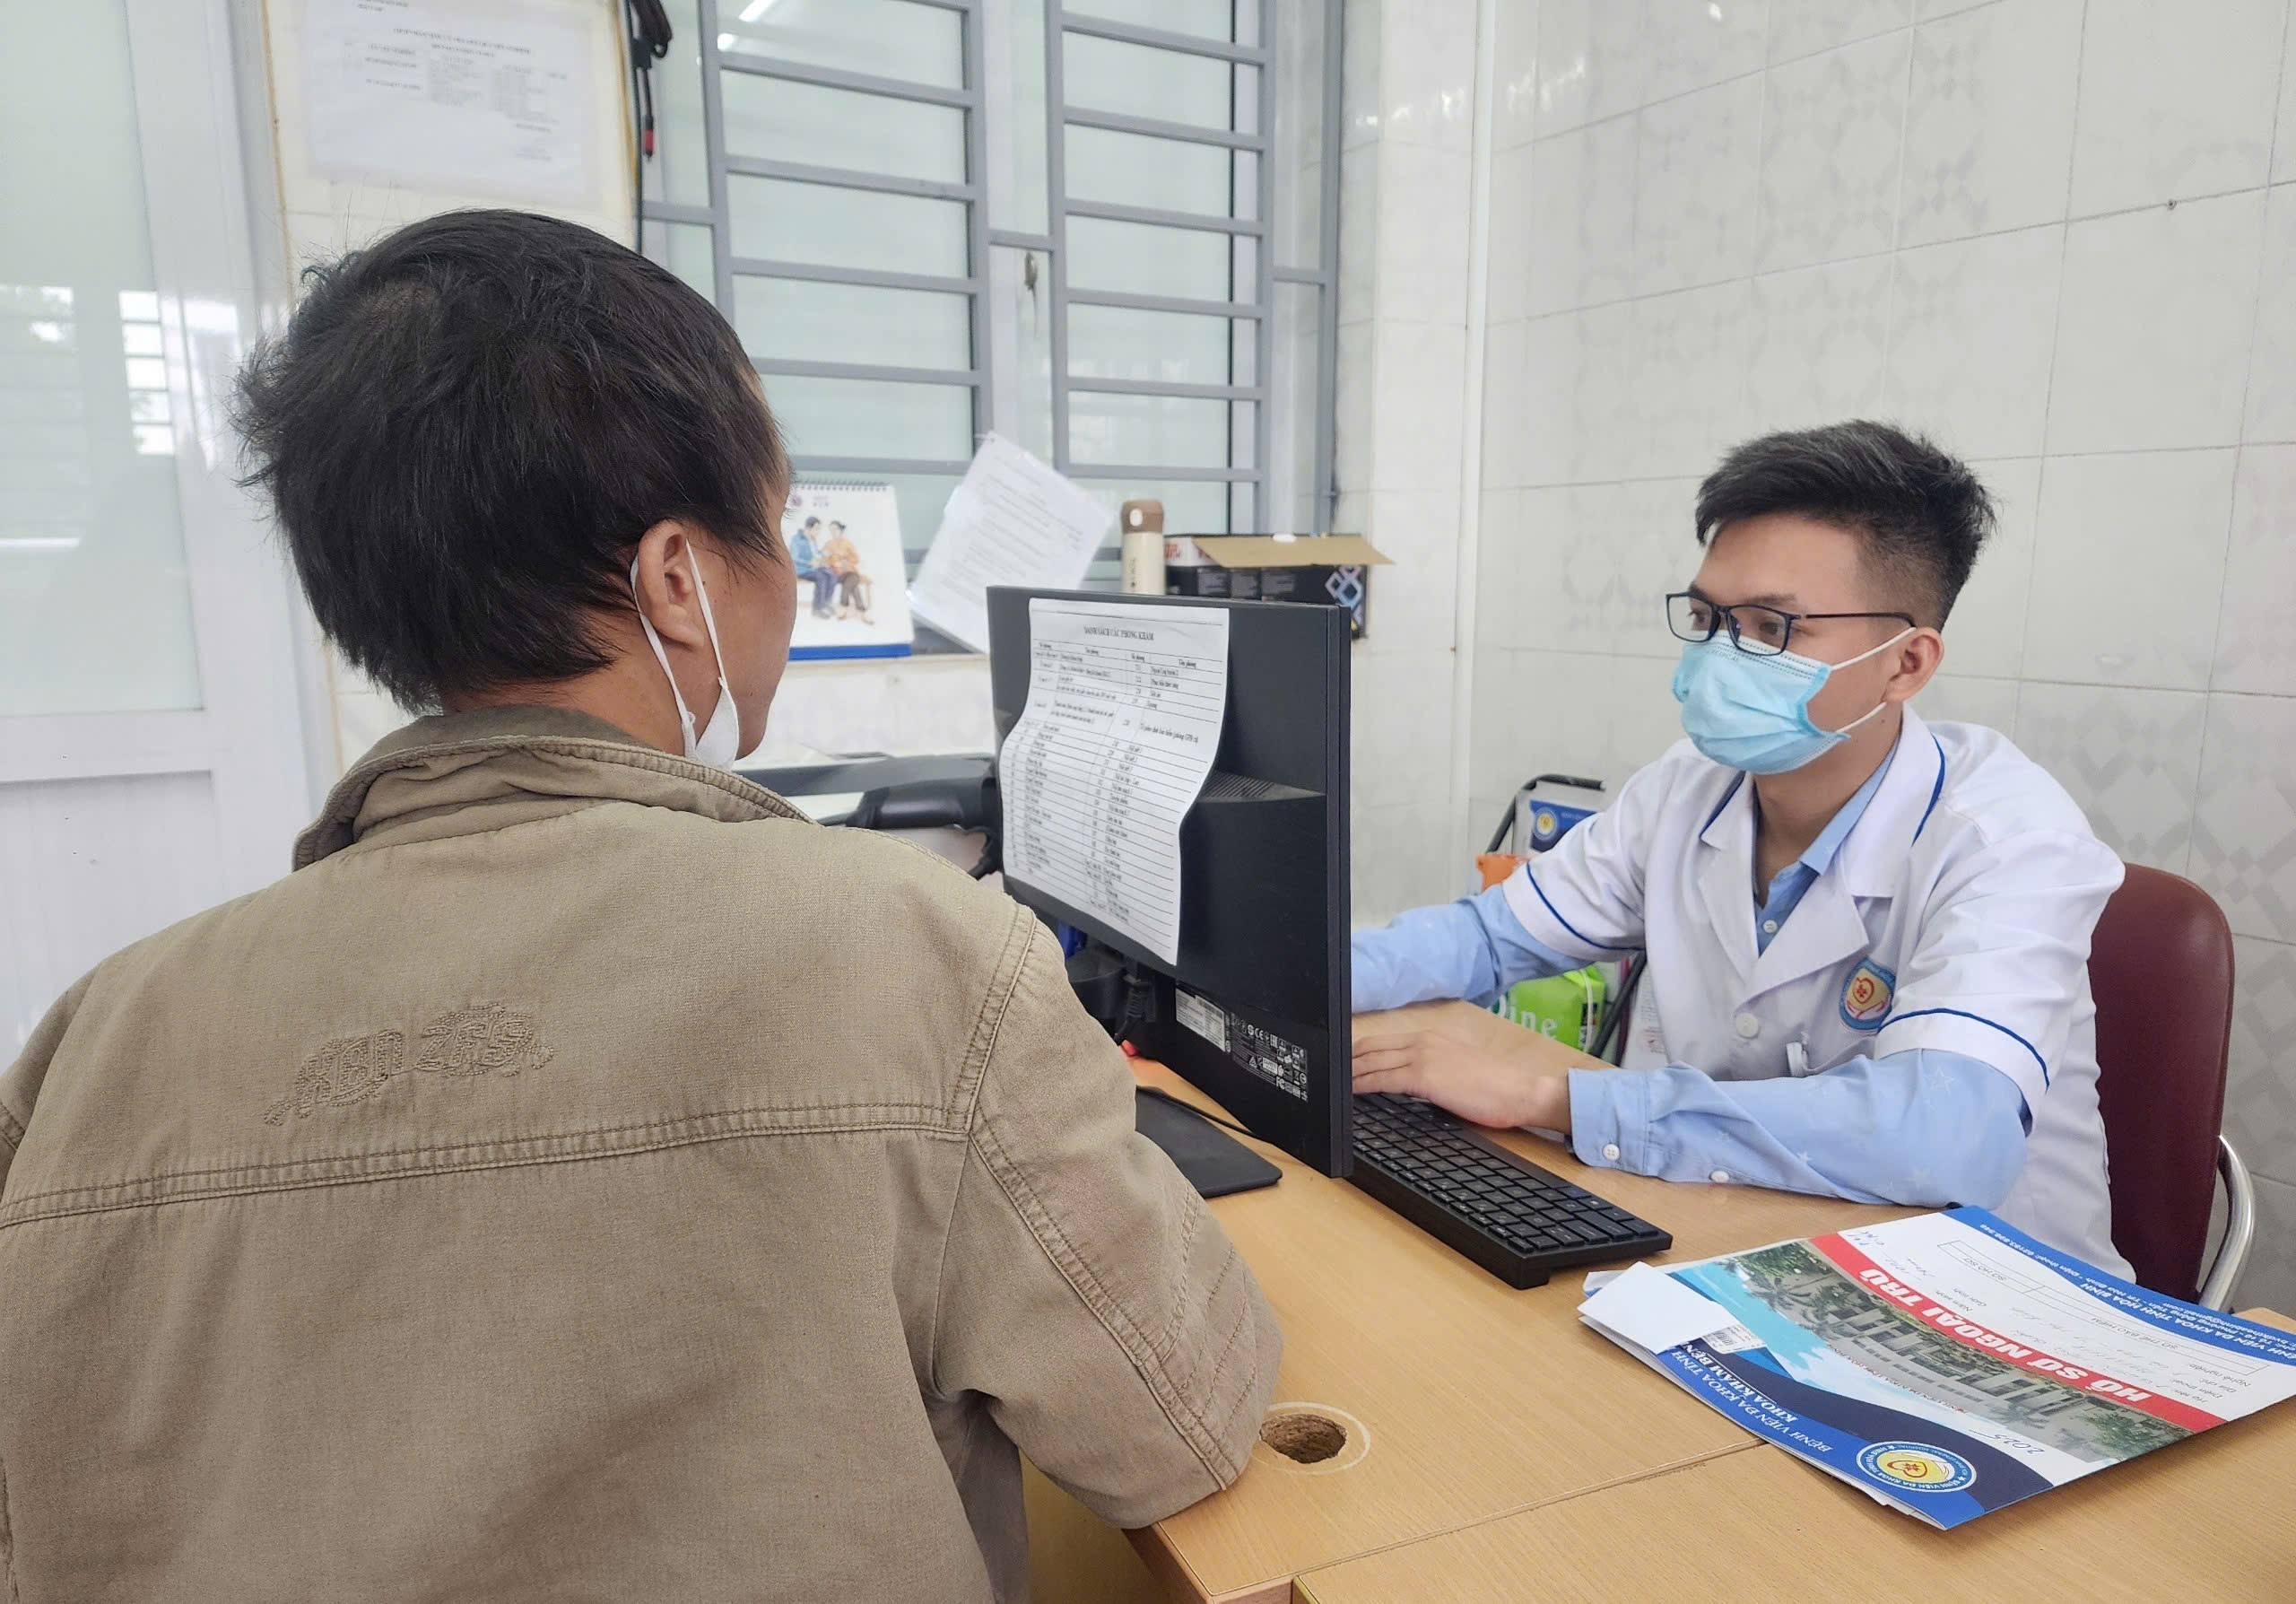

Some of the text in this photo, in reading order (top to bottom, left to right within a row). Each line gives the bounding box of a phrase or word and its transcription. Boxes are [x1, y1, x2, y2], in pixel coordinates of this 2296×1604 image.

[2080, 1283, 2113, 1298] BÌNH
[2175, 1319, 2213, 1333] KHOA
[1859, 1268, 2152, 1402] HỒ SƠ NGOẠI TRÚ
[1671, 1350, 1834, 1452] BỆNH VIỆN ĐA KHOA TỈNH
[1682, 1343, 1798, 1423] KHOA KHÁM BỆN
